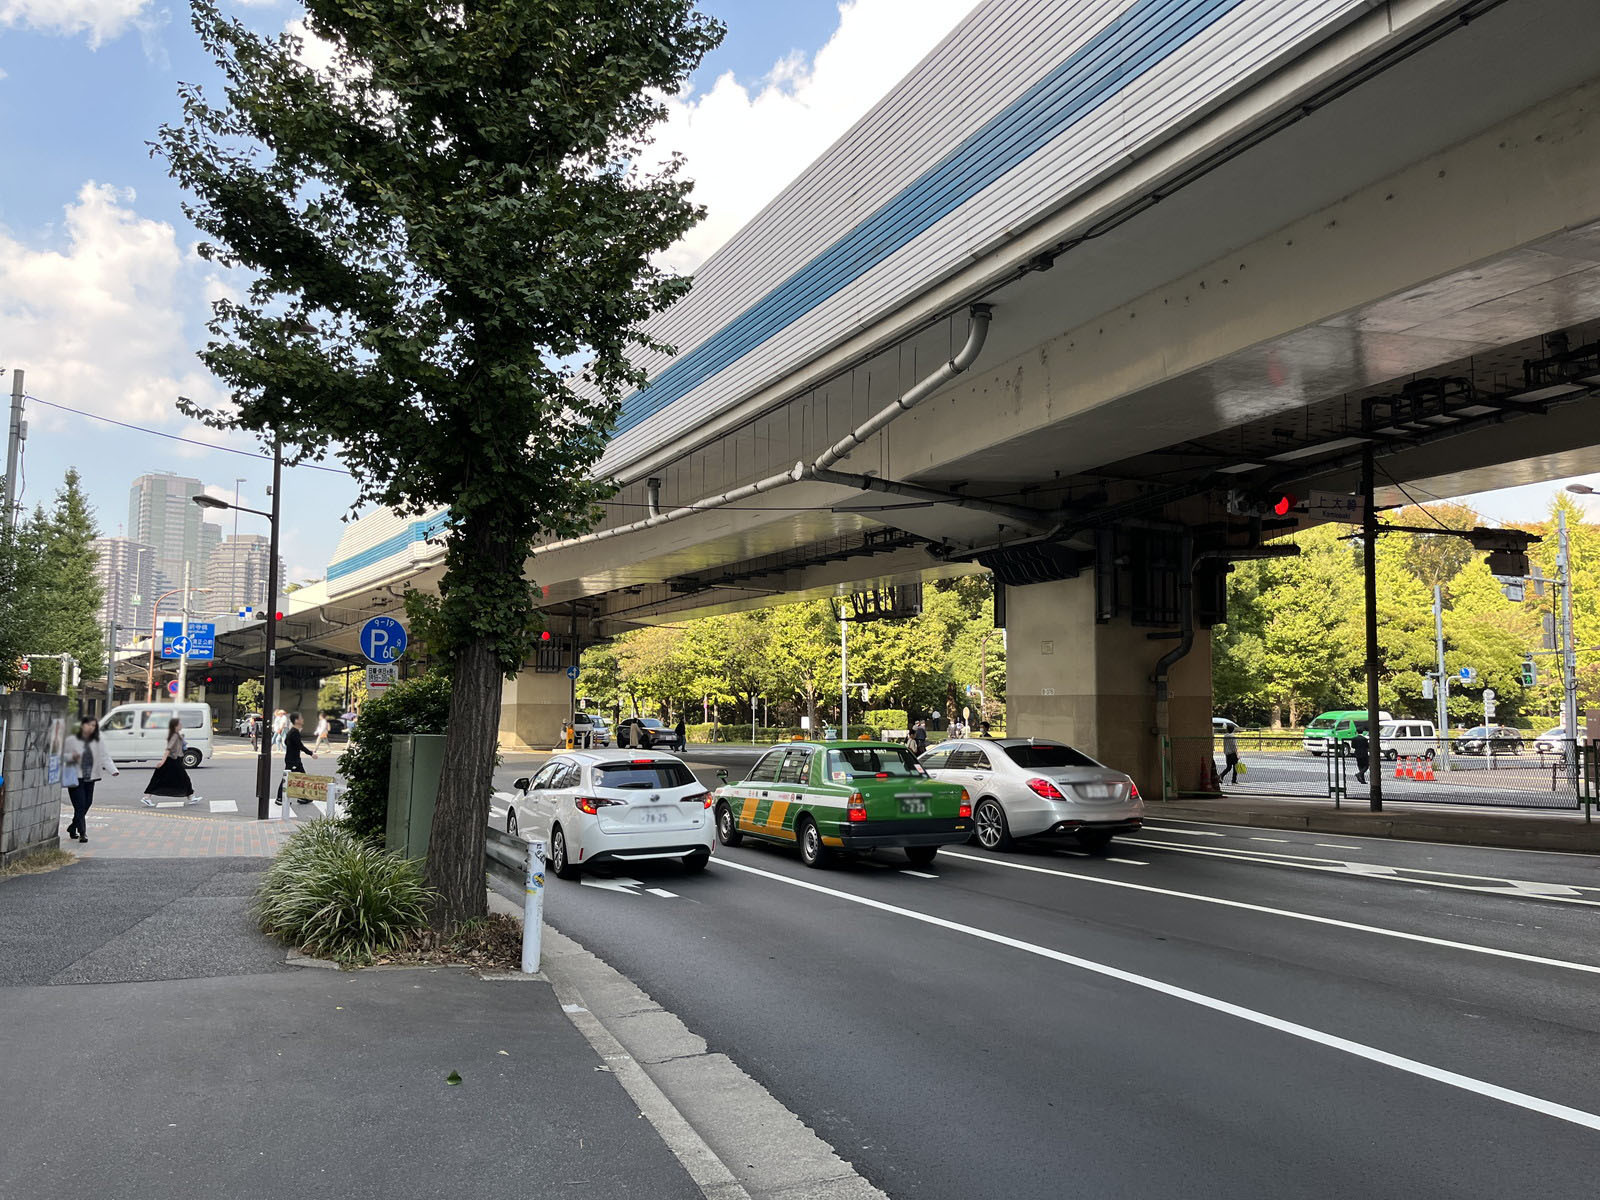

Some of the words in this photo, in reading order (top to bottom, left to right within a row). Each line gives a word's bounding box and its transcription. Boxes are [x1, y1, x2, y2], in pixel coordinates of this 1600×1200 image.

[1317, 495, 1356, 511] 上大崎
[374, 619, 395, 627] 9-19
[370, 629, 389, 658] P
